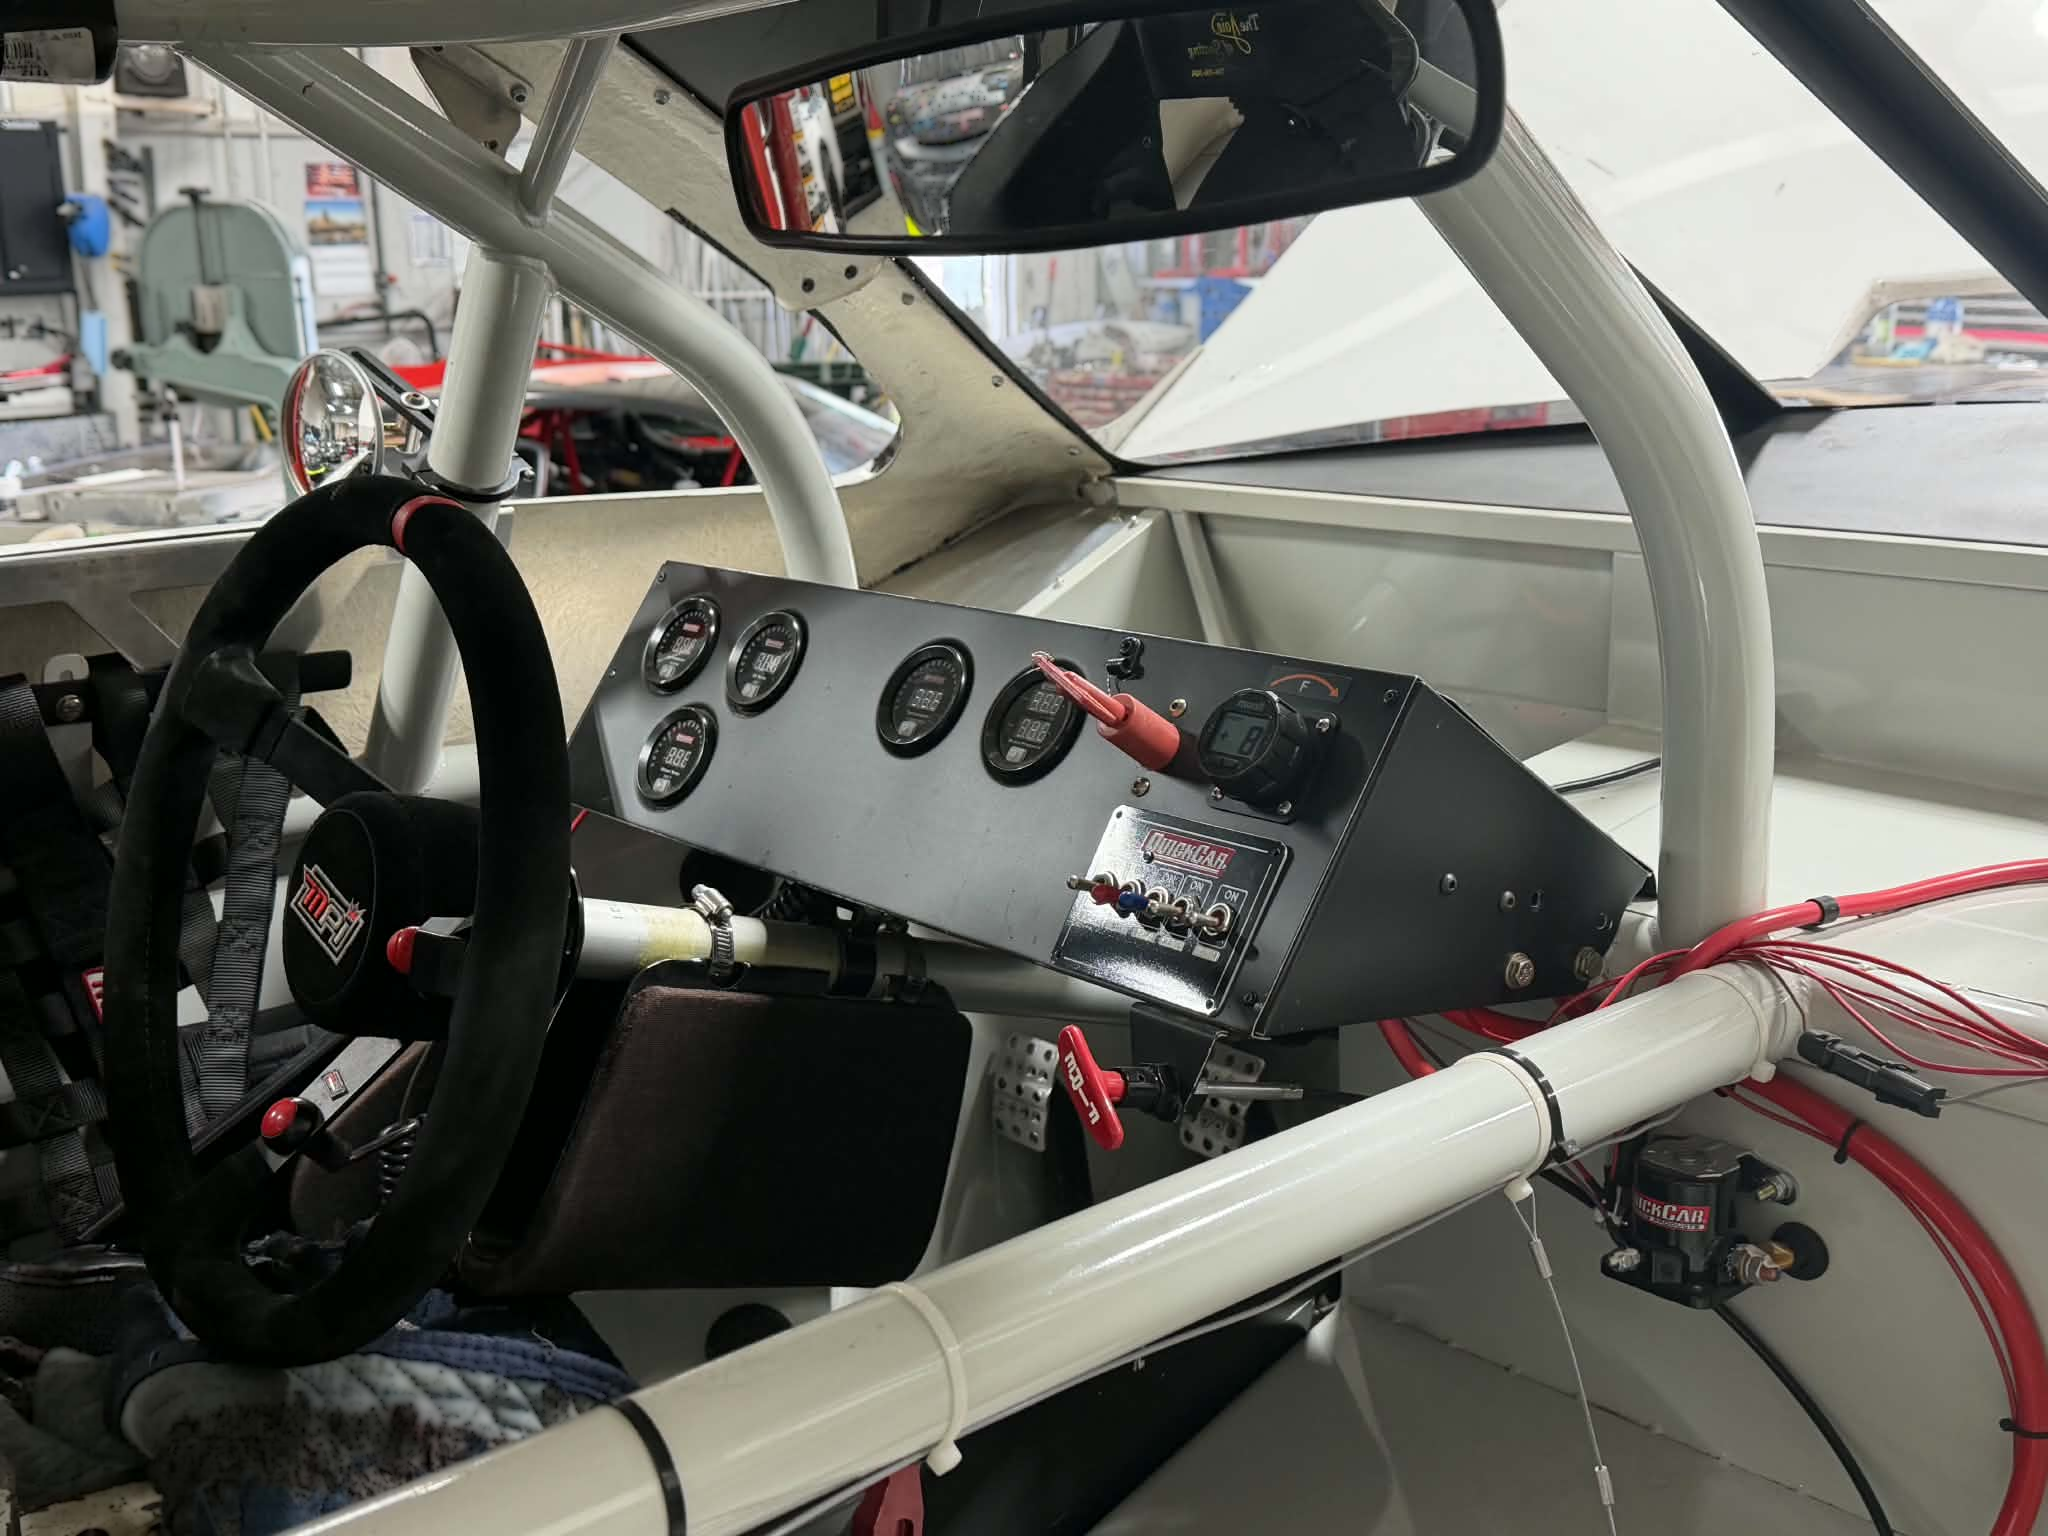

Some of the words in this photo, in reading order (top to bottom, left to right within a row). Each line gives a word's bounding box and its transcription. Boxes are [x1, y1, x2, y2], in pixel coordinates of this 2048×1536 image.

[1299, 680, 1311, 694] F
[1190, 880, 1205, 891] ON
[1224, 889, 1240, 901] ON
